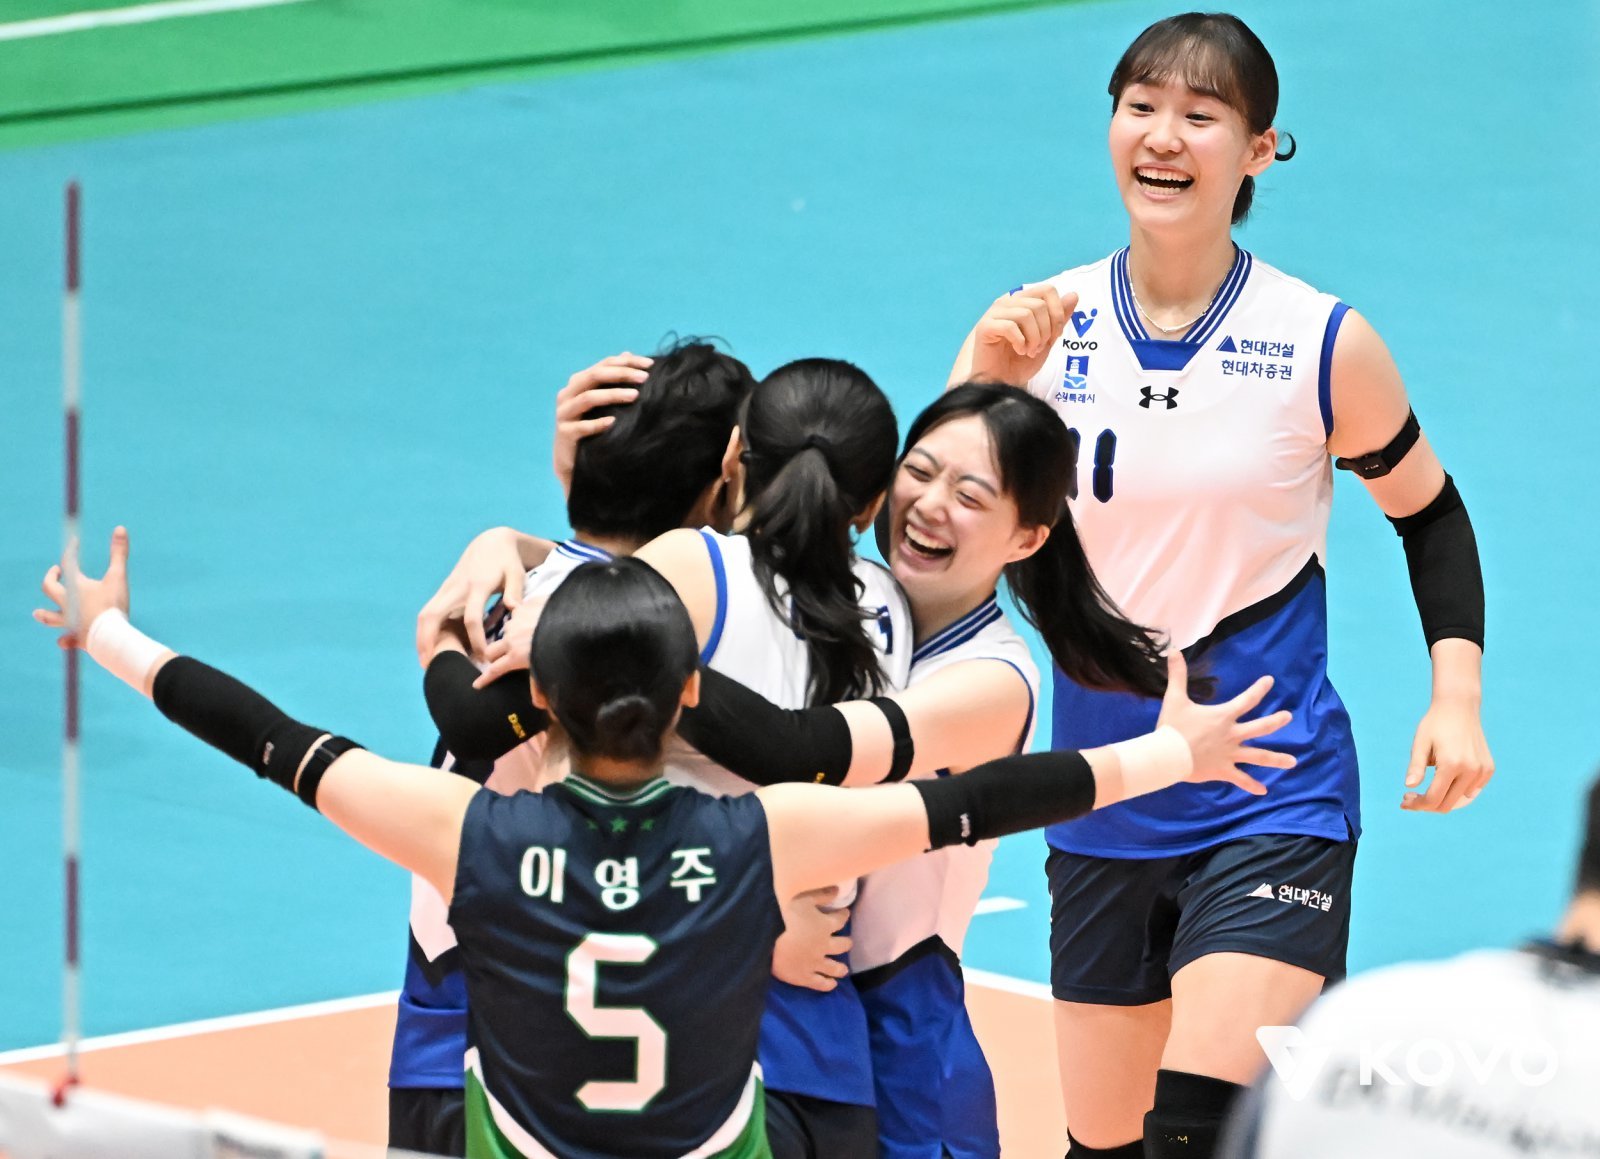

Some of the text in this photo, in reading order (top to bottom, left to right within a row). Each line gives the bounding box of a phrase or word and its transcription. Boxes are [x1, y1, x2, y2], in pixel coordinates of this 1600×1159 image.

[1062, 338, 1098, 351] KOVO
[1240, 339, 1295, 358] 현대건설
[1221, 359, 1293, 380] 현대차증권
[520, 846, 717, 912] 이영주
[1278, 884, 1333, 912] 현대건설
[565, 932, 668, 1112] 5
